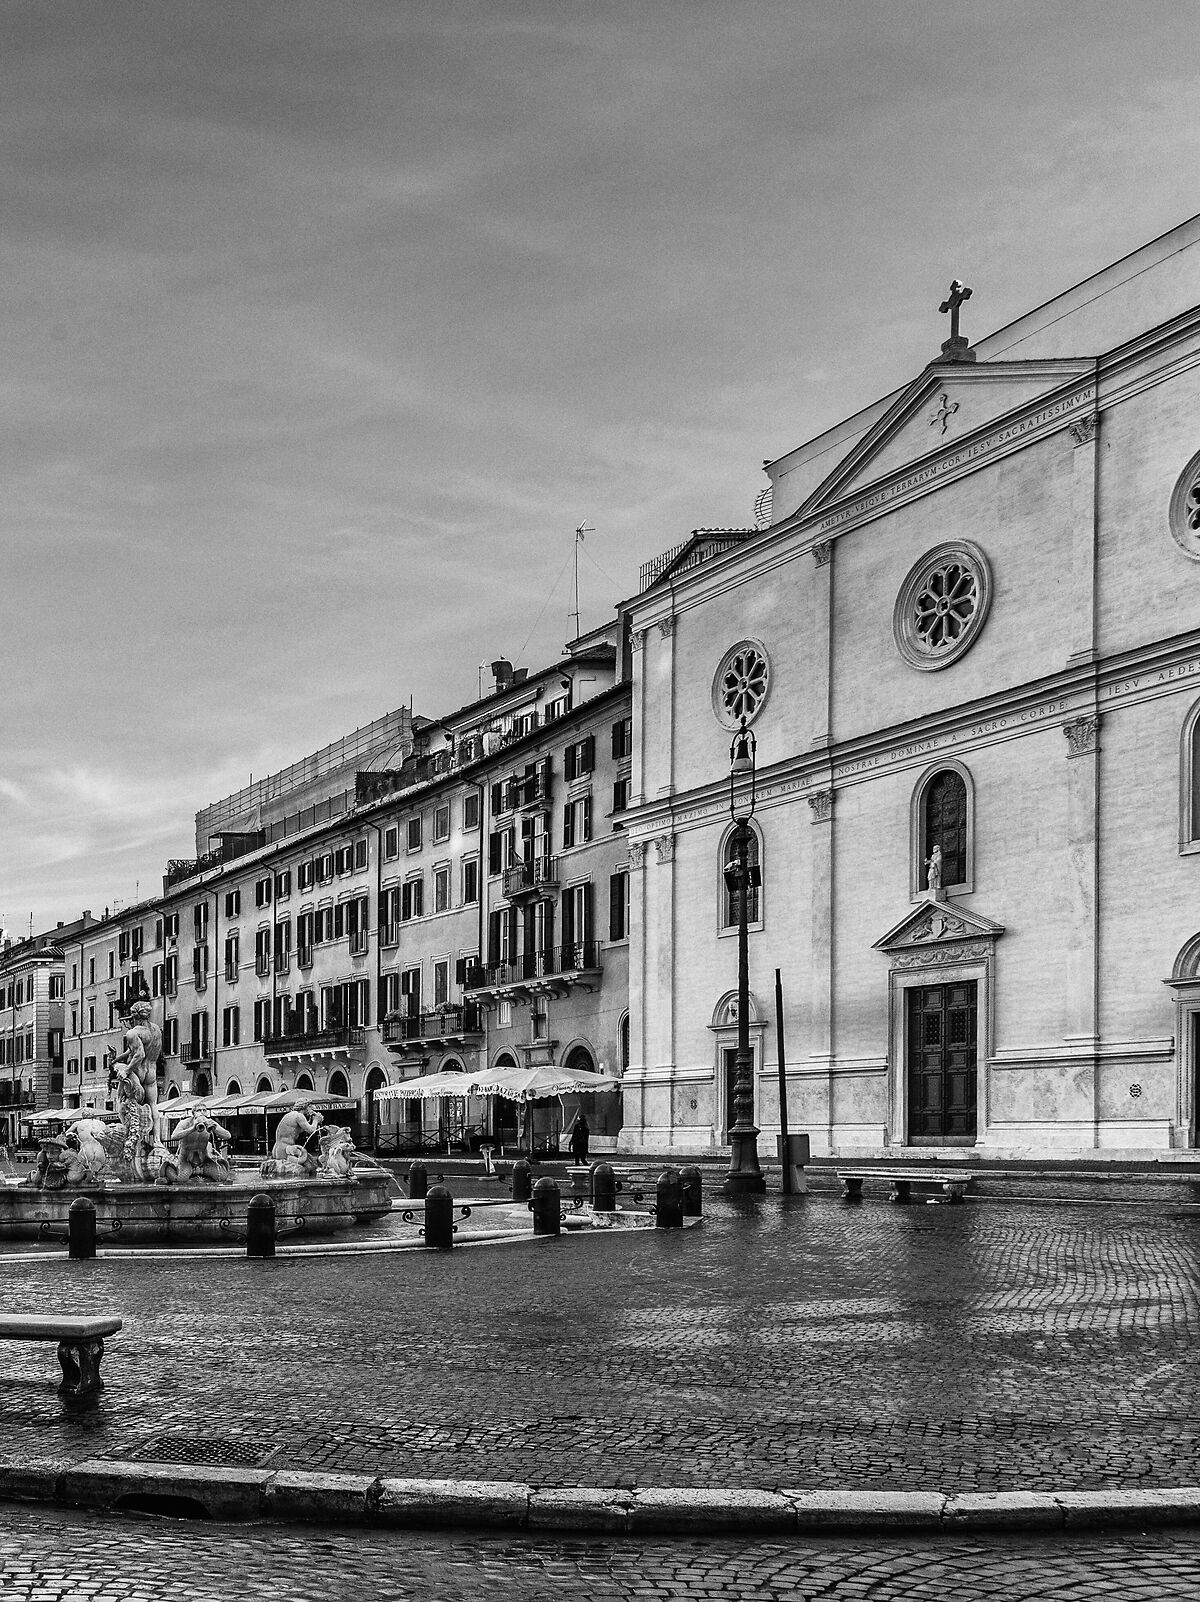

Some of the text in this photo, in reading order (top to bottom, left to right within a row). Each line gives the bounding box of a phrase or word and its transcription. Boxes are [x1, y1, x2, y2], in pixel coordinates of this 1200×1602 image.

[820, 390, 1092, 530] AMETVR VBIQVE TERRARVM COR IESV SACRATISSIMVM
[646, 818, 671, 830] OPTIMO
[678, 808, 709, 822] MAXIMO
[780, 779, 810, 792] MARIAE
[838, 758, 880, 776] NOSTRAE
[890, 740, 939, 760] DOMINAE
[951, 734, 958, 742] A
[971, 718, 1007, 736] SACRO
[1020, 700, 1067, 722] CORDE
[1108, 680, 1140, 696] IESV
